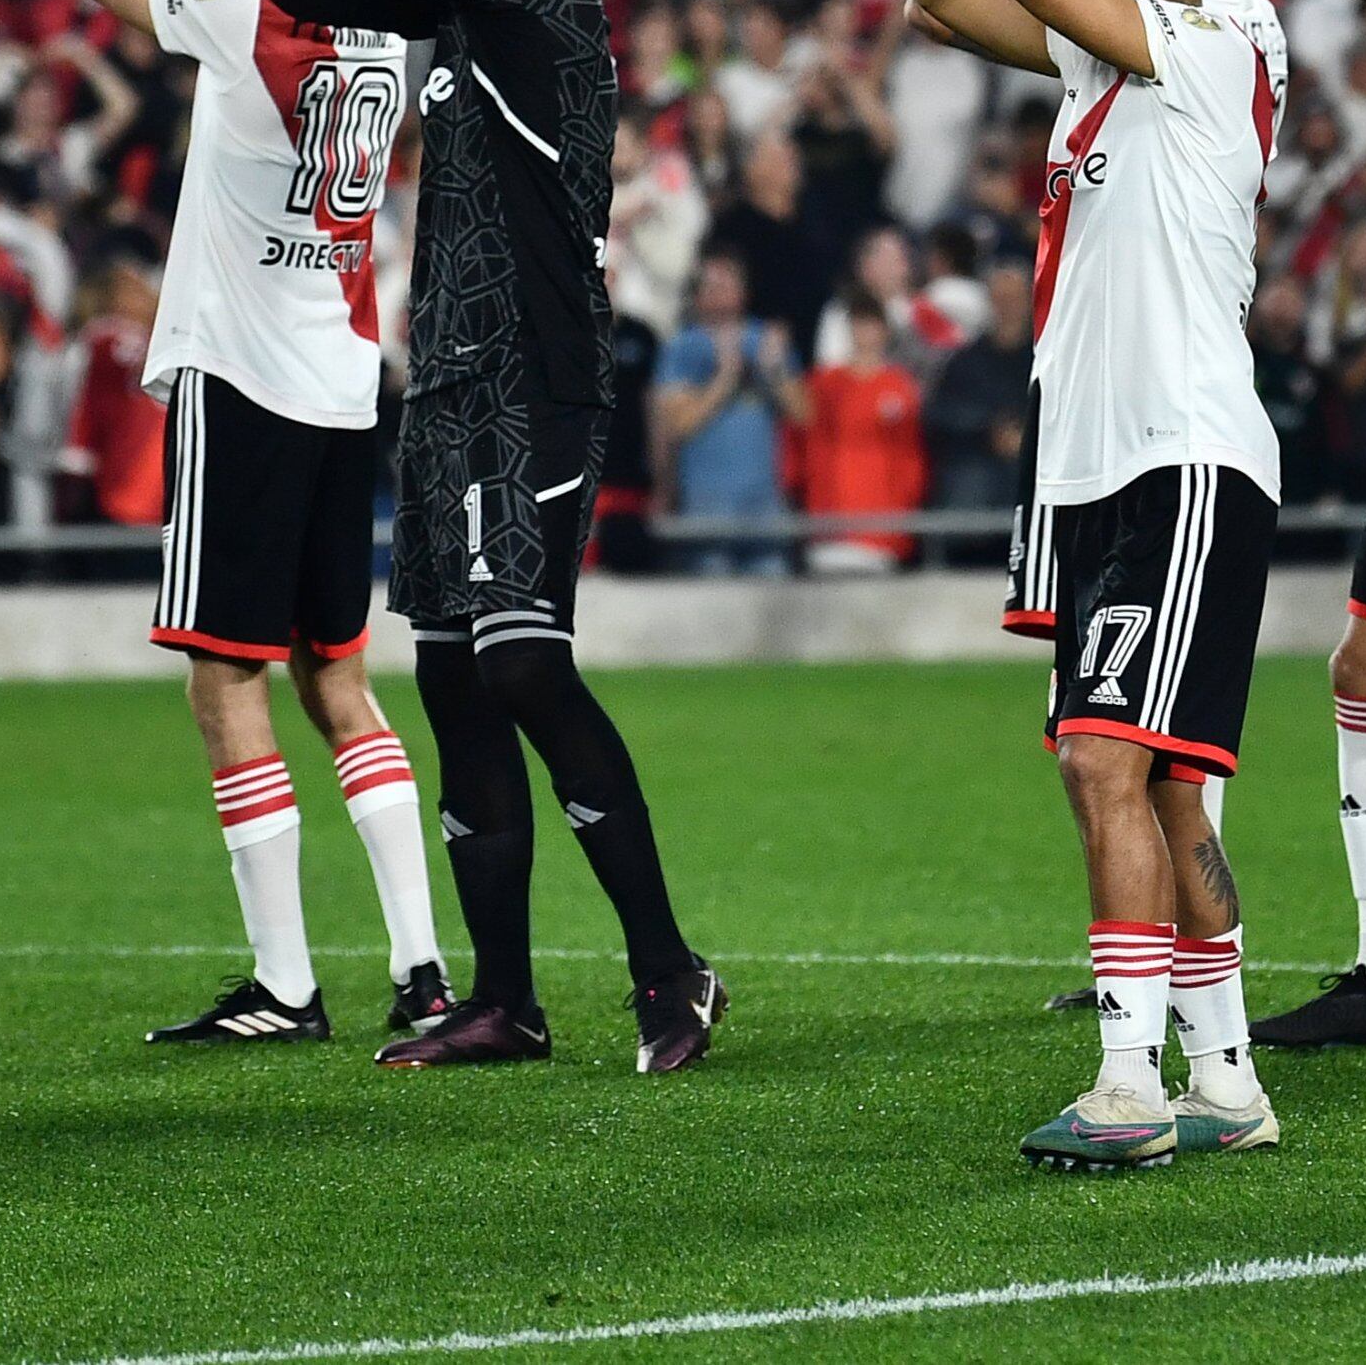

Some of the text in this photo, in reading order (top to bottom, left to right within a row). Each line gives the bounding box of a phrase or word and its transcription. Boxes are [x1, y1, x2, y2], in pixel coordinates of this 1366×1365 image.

[286, 61, 400, 222] 10
[259, 236, 368, 274] DIRECTV
[463, 483, 482, 554] 1
[1079, 604, 1153, 679] 17
[1087, 694, 1129, 707] adidas
